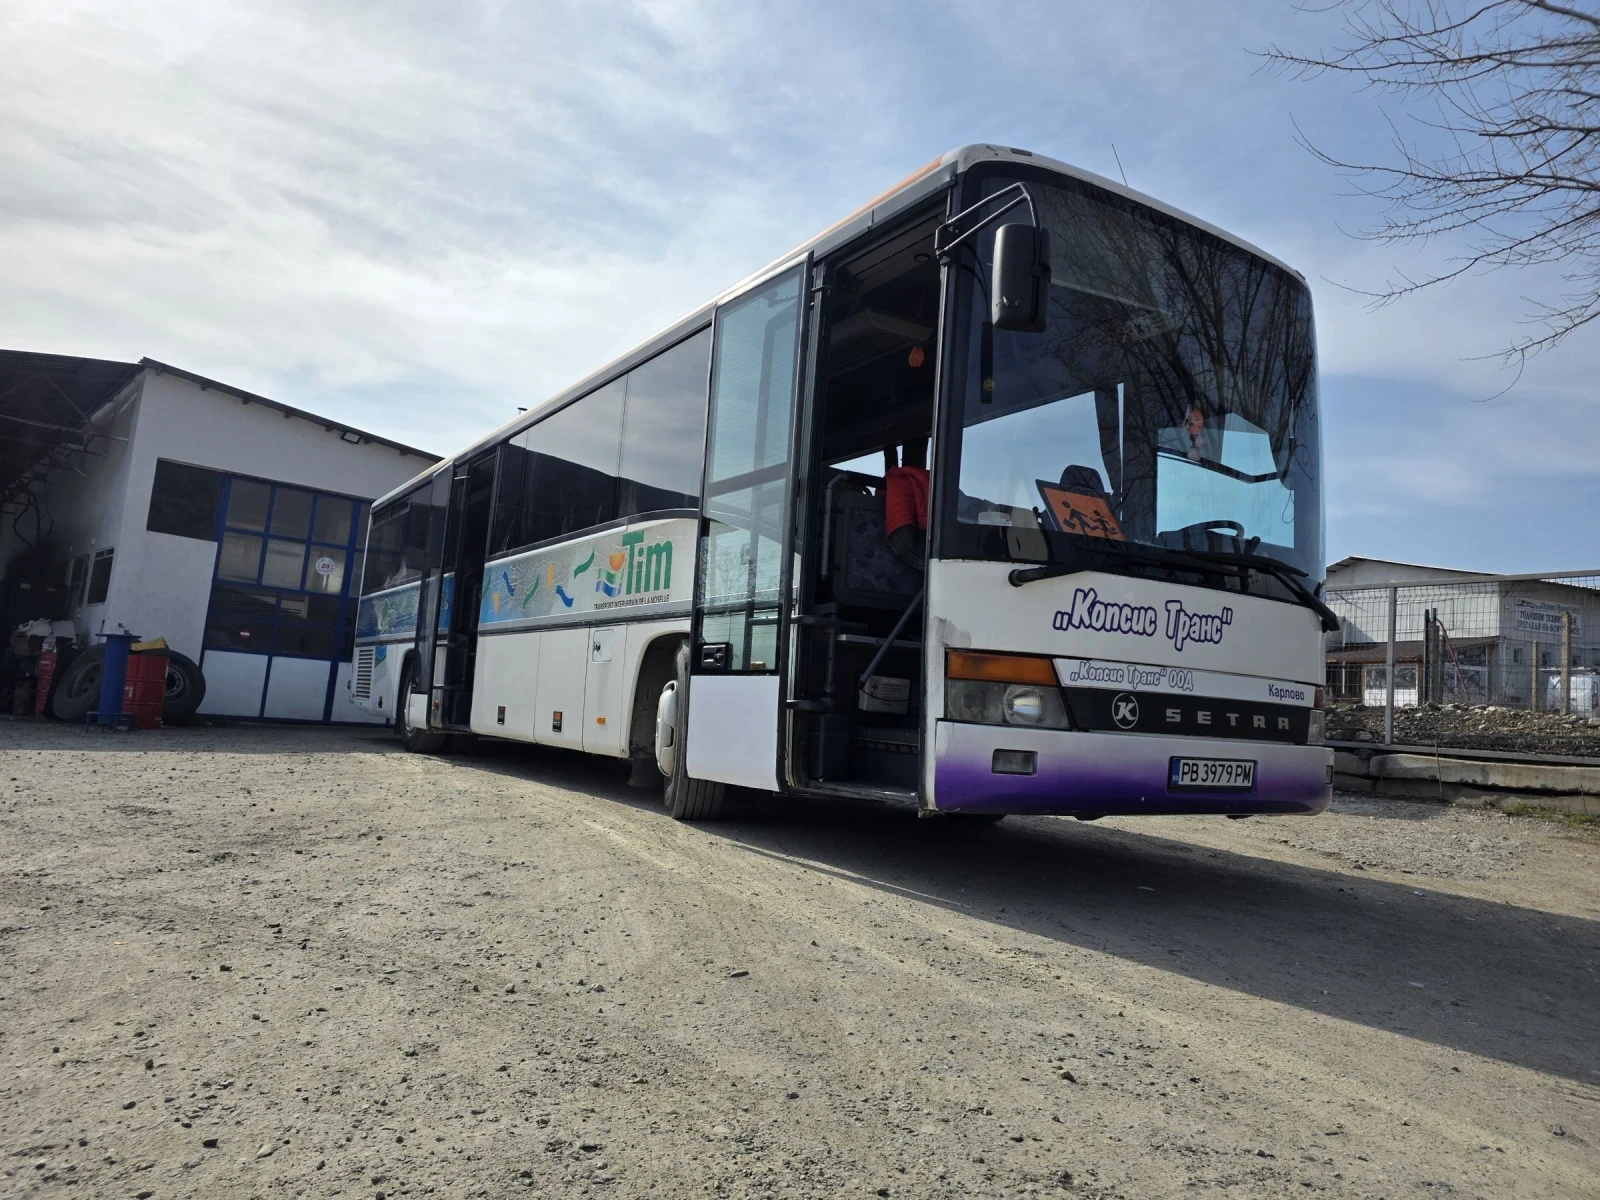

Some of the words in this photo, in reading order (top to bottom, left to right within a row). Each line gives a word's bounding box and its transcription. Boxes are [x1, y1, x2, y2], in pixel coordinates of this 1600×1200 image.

[622, 529, 673, 595] Tim
[594, 601, 614, 610] TRANSPORT
[639, 597, 644, 605] DE
[645, 596, 650, 604] LA
[651, 594, 670, 603] MOSELLE
[1169, 669, 1194, 691] ООД
[1268, 684, 1305, 701] Карлово
[1166, 708, 1290, 730] SETRA
